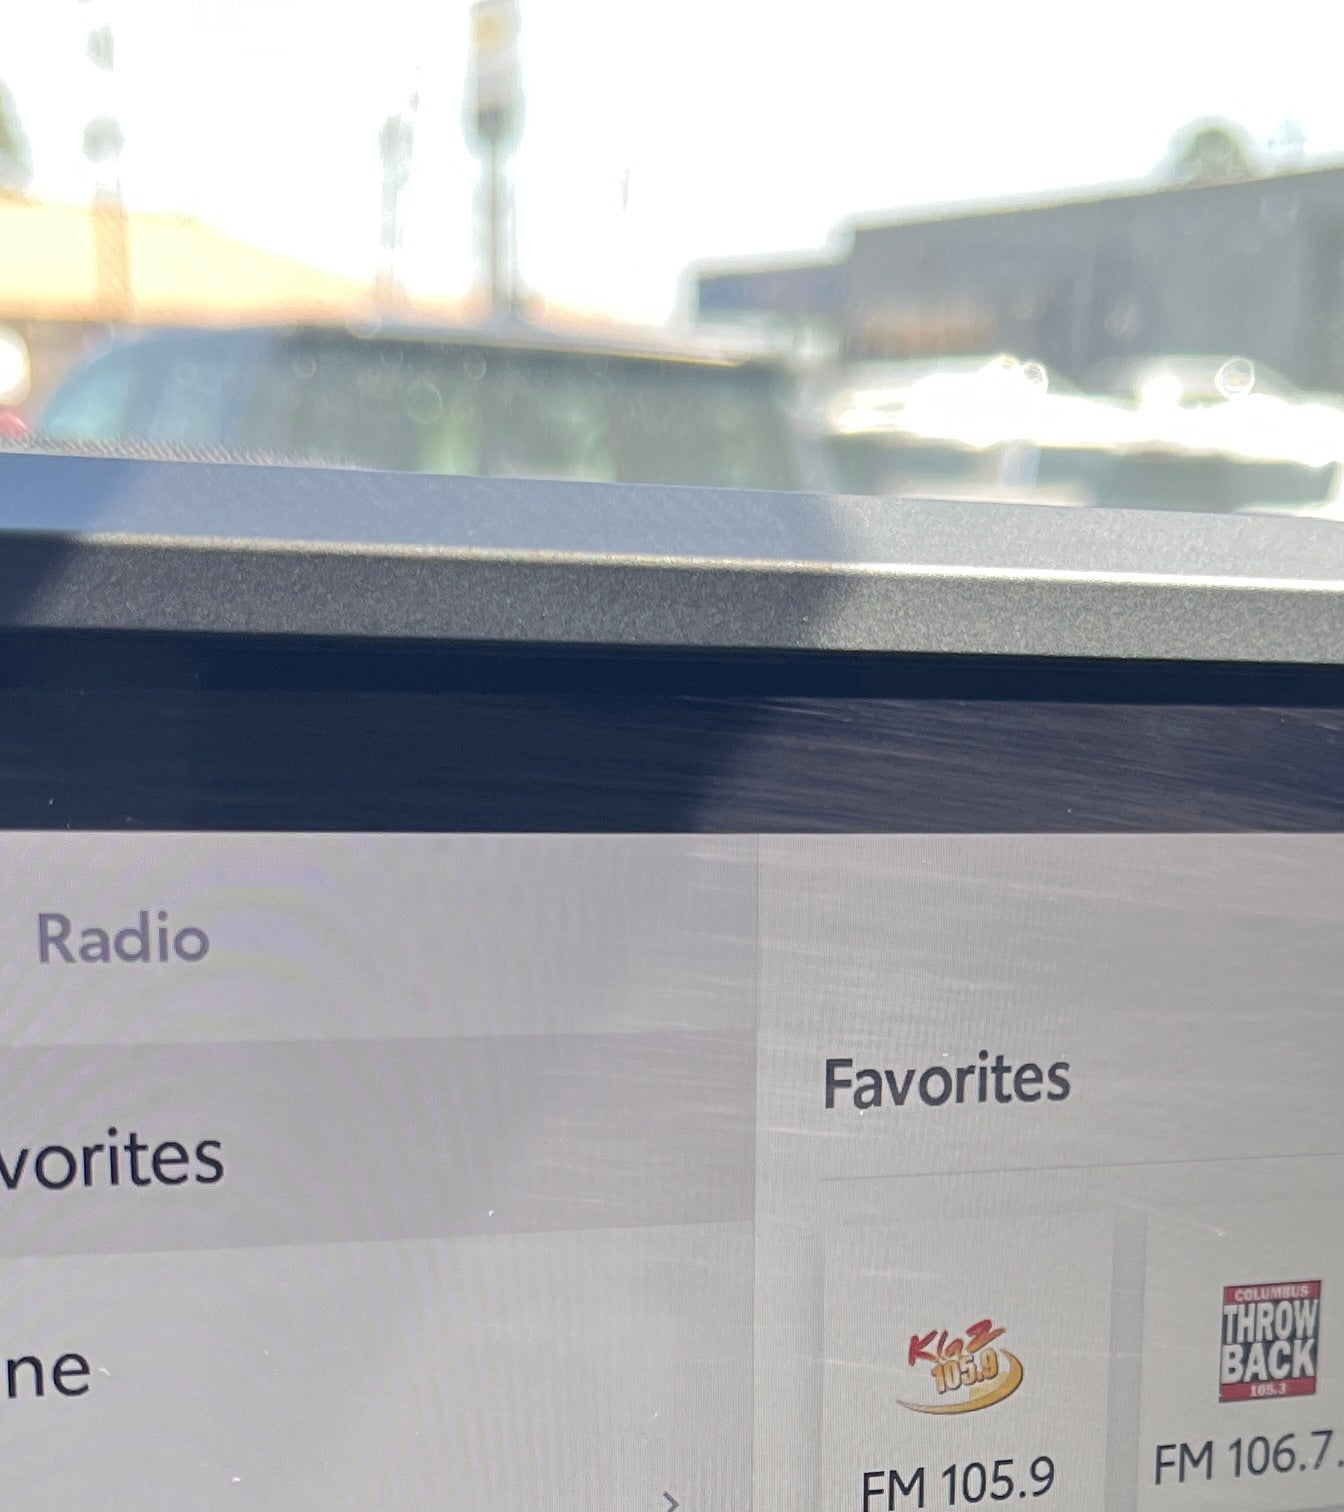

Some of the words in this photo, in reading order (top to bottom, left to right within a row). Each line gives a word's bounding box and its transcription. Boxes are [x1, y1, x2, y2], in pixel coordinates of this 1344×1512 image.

[37, 909, 210, 964] Radio
[825, 1049, 1071, 1110] Favorites
[1233, 1284, 1310, 1303] COLUMBUS
[1222, 1298, 1320, 1346] THROW
[1220, 1337, 1316, 1386] BACK
[942, 1455, 1055, 1506] 105.9
[1155, 1440, 1214, 1485] FM
